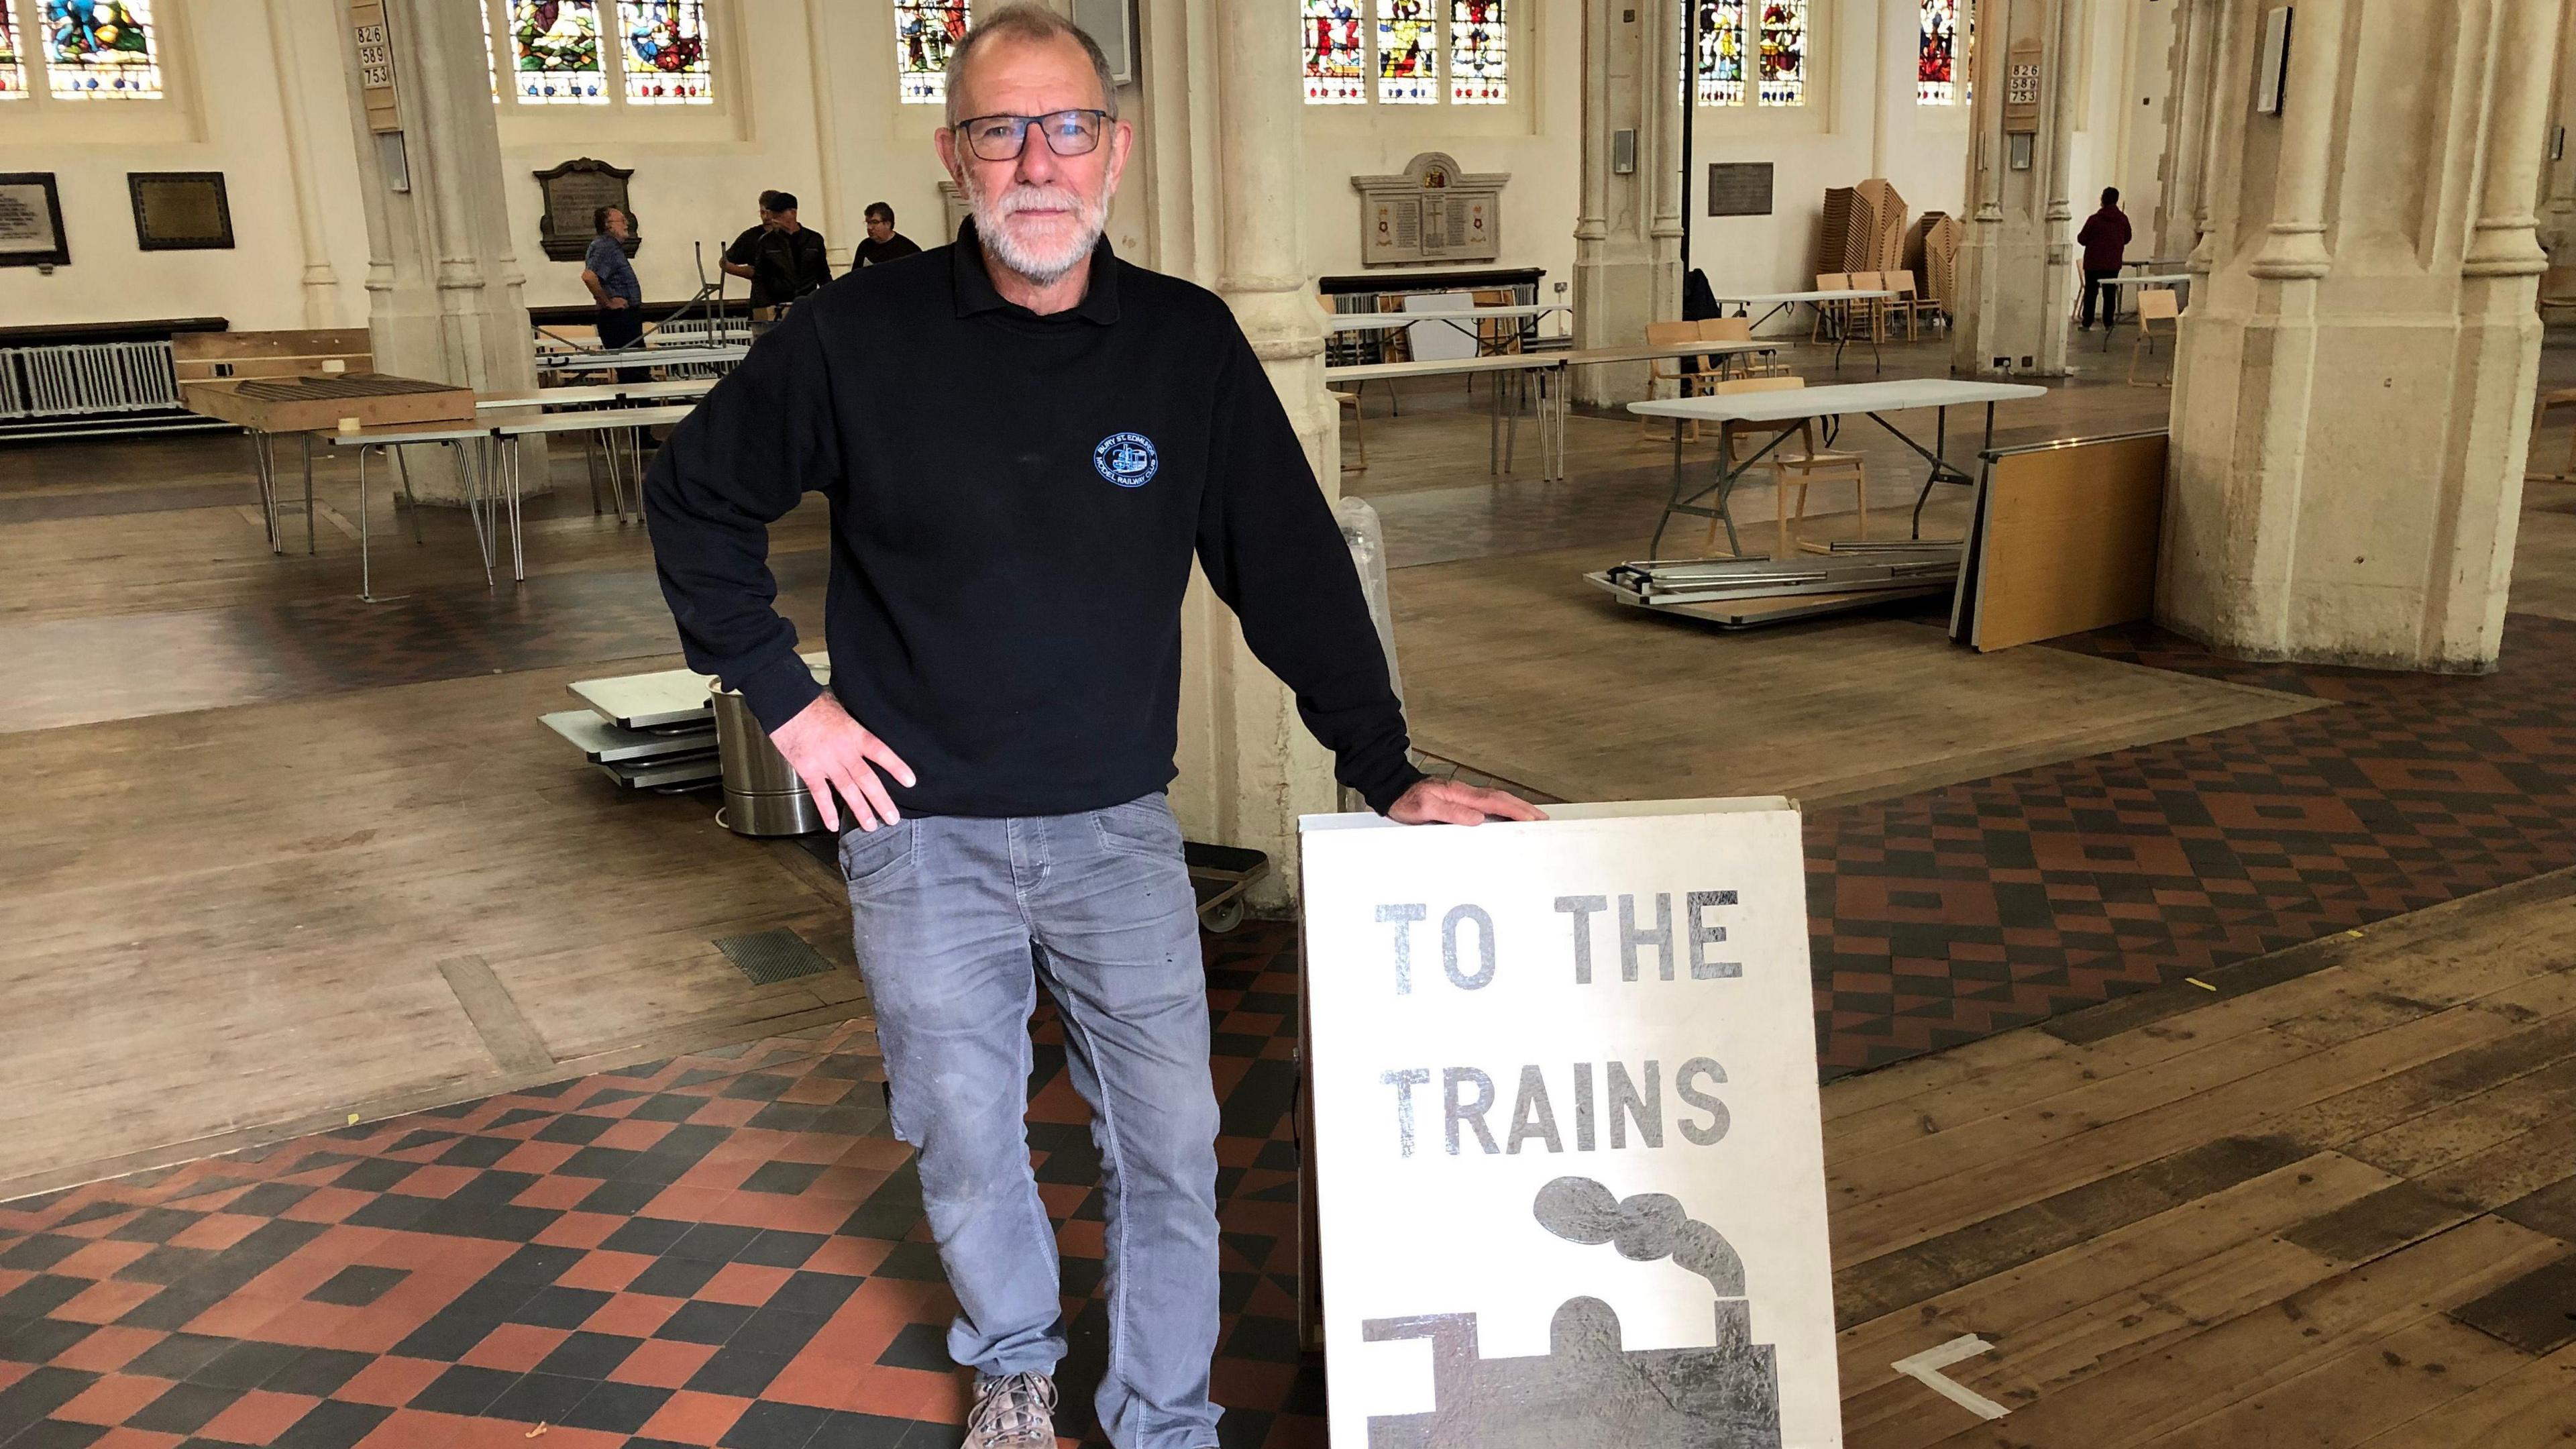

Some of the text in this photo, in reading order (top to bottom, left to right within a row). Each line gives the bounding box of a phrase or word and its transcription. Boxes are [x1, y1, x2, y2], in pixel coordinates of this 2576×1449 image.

[358, 28, 381, 43] 826
[362, 47, 383, 63] 589
[365, 66, 386, 84] 753
[2013, 66, 2038, 75] 826
[2012, 78, 2036, 89] 589
[2012, 91, 2035, 101] 753
[1097, 438, 1116, 454] BURY
[1127, 435, 1155, 456] EDMUNDS
[1095, 457, 1156, 485] MODEL RAILWAY CLUB
[1375, 890, 1743, 995] TO THE
[1379, 1056, 1731, 1158] TRAINS
